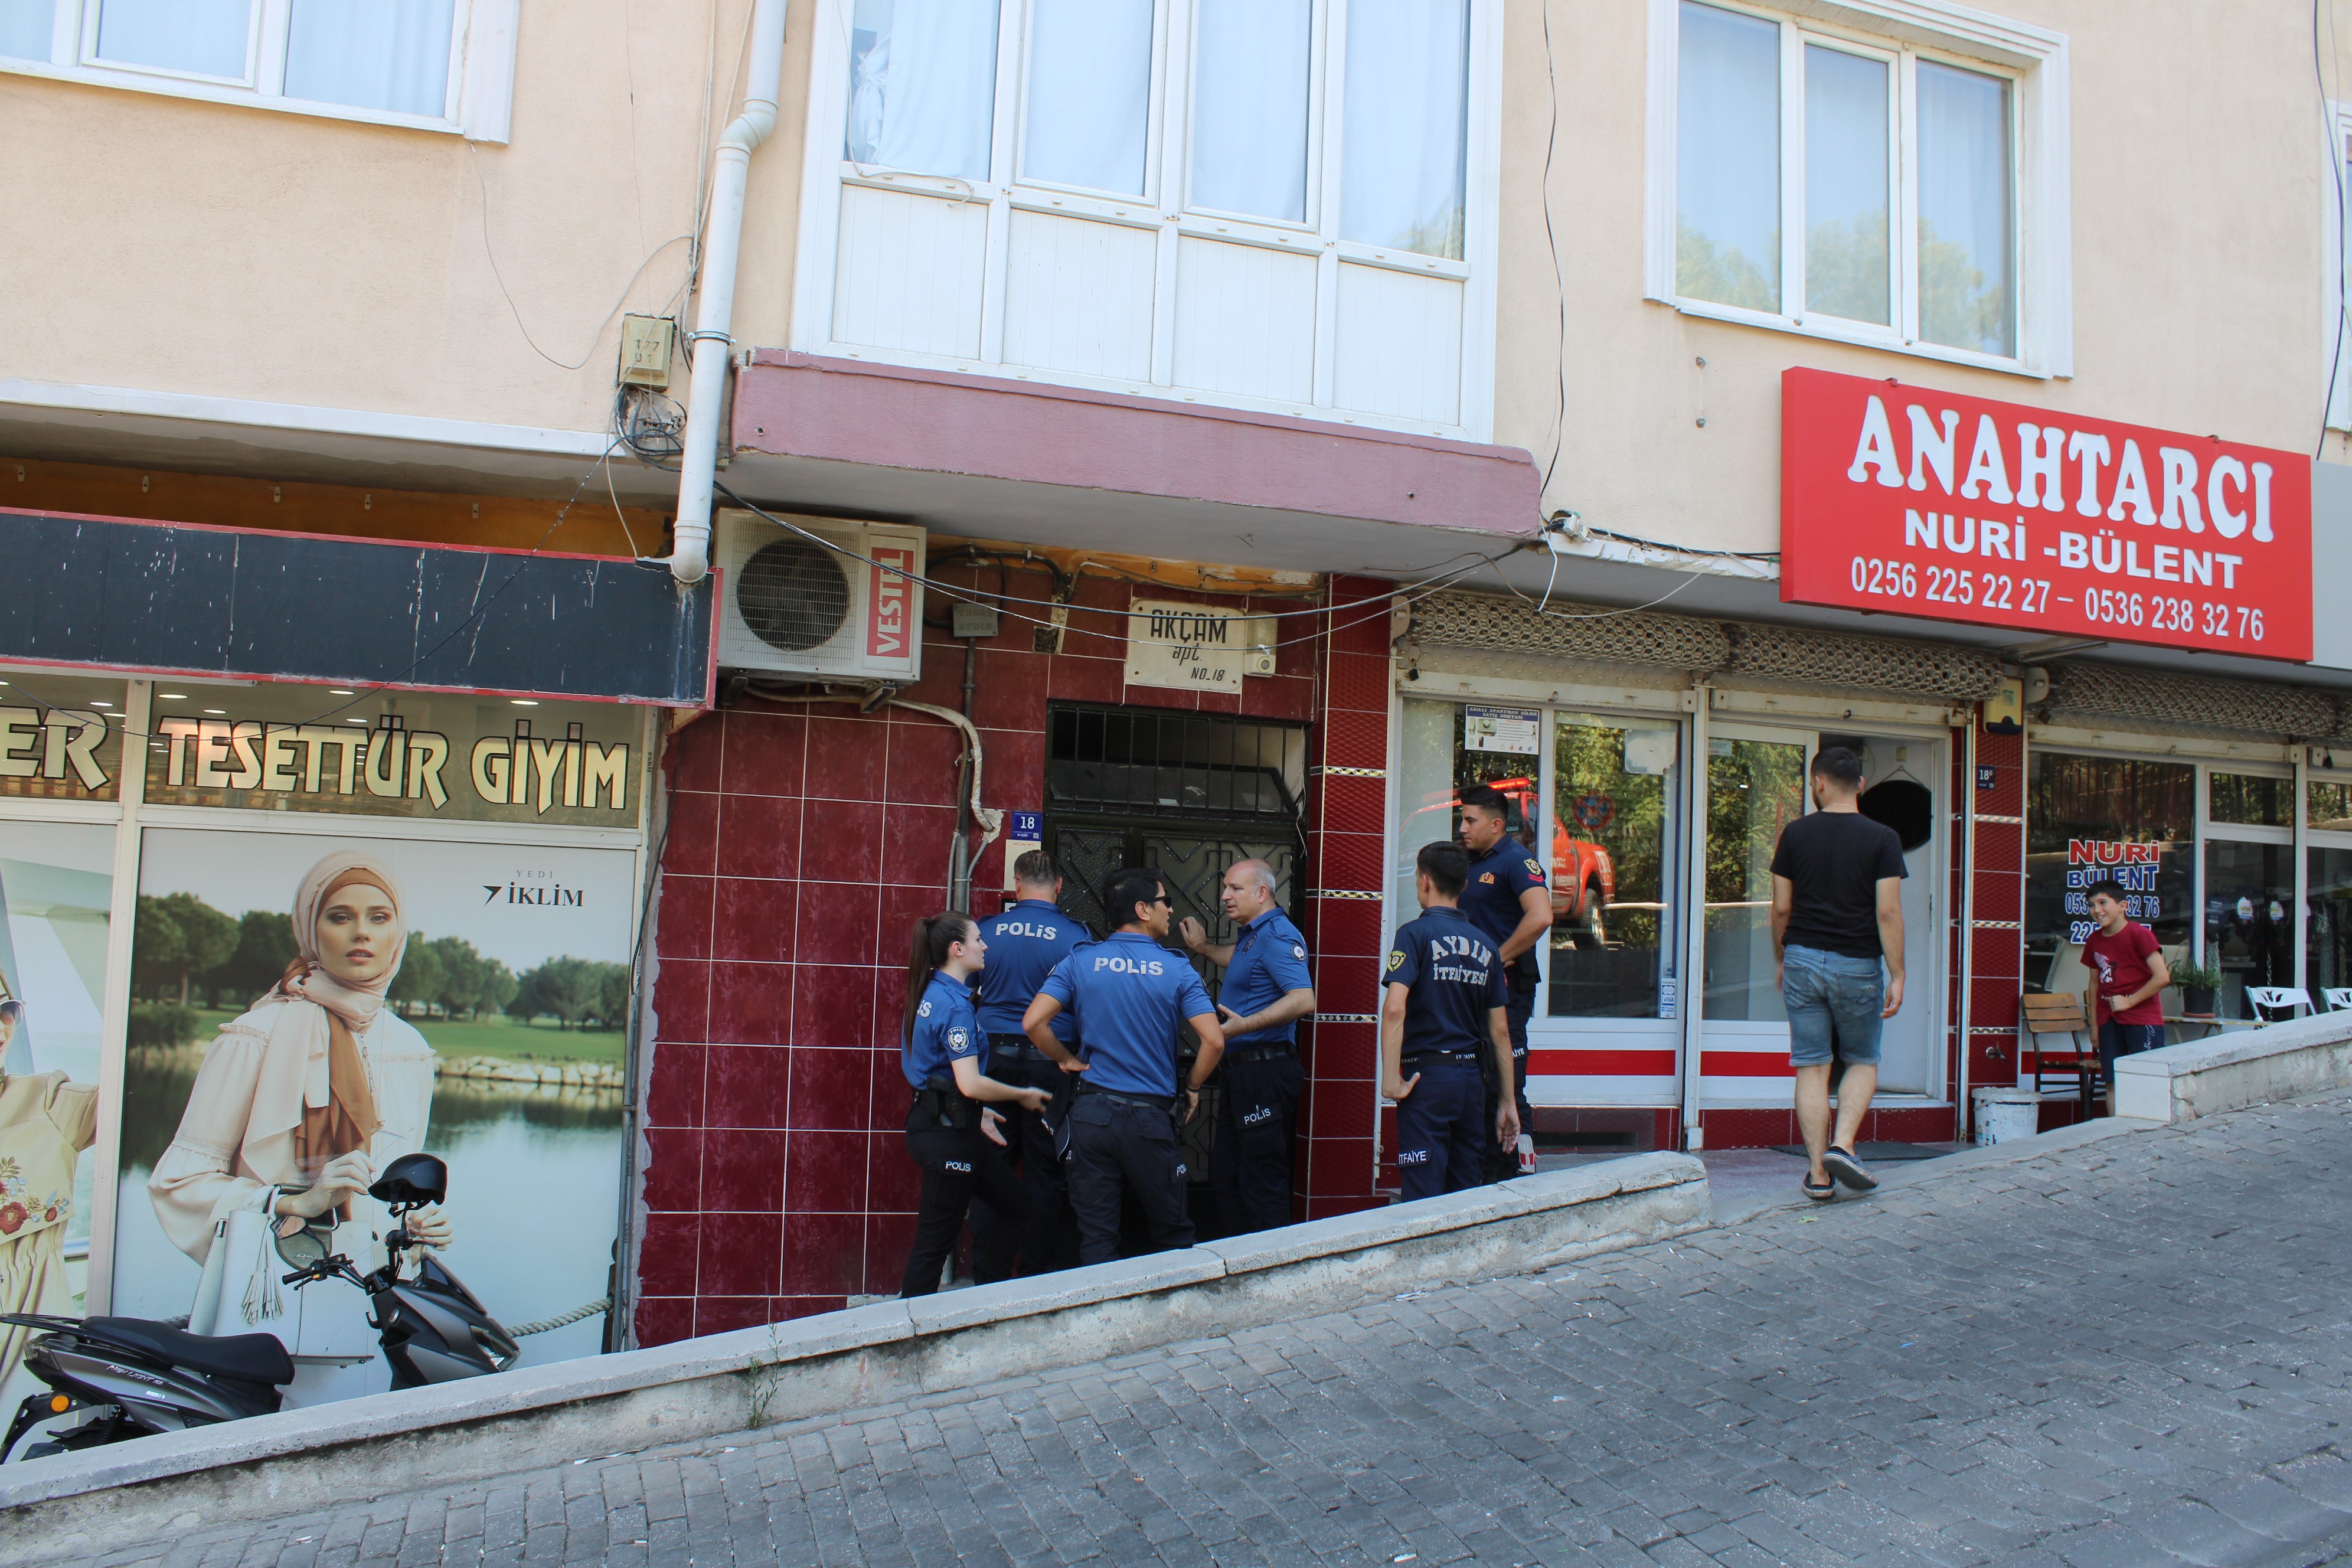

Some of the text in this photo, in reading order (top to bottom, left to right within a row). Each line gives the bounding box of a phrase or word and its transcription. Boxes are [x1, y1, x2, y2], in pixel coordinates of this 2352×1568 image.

[1847, 394, 2274, 543] ANAHTARCI
[876, 551, 904, 654] VESTEL
[1851, 556, 1917, 598] 0256
[1926, 566, 1974, 605] 225
[1982, 573, 2012, 610] 22
[2021, 577, 2051, 613] 27
[2085, 587, 2143, 626] 0536
[2152, 596, 2194, 633] 238
[2203, 602, 2229, 637] 32
[2236, 606, 2263, 642] 76
[1151, 609, 1227, 644] AKÇAM
[156, 714, 450, 811] TESETTÜR
[471, 718, 631, 816] GİYİM
[1020, 816, 1035, 829] 18
[516, 870, 553, 879] YEDİ
[507, 881, 585, 907] İKLİM
[2143, 896, 2160, 918] 76
[1430, 935, 1492, 968] AYDIN
